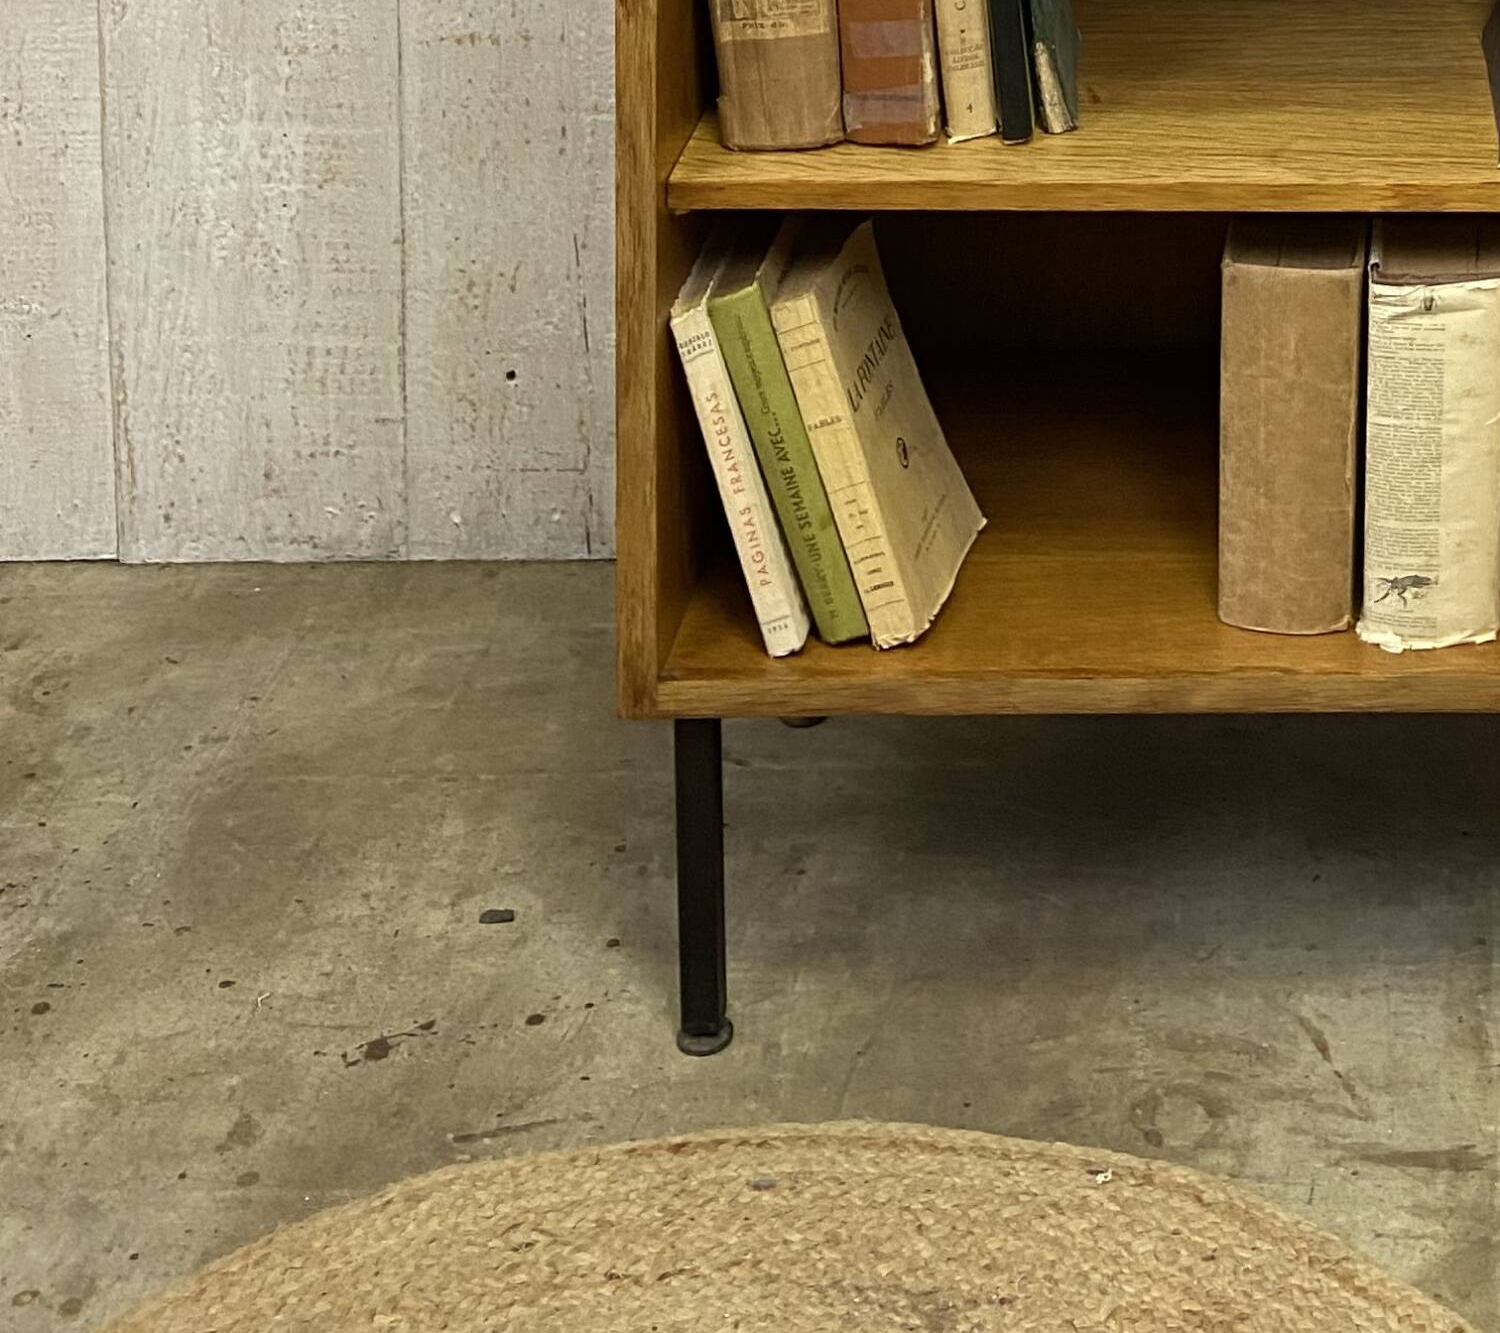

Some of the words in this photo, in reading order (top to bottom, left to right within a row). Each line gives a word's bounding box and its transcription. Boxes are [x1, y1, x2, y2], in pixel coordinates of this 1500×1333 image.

[966, 102, 974, 114] 4
[847, 379, 863, 413] LA
[706, 392, 745, 495] FRANCESAS
[781, 466, 812, 529] SEMAINE
[739, 506, 773, 587] PAGINAS
[803, 534, 821, 562] UNE
